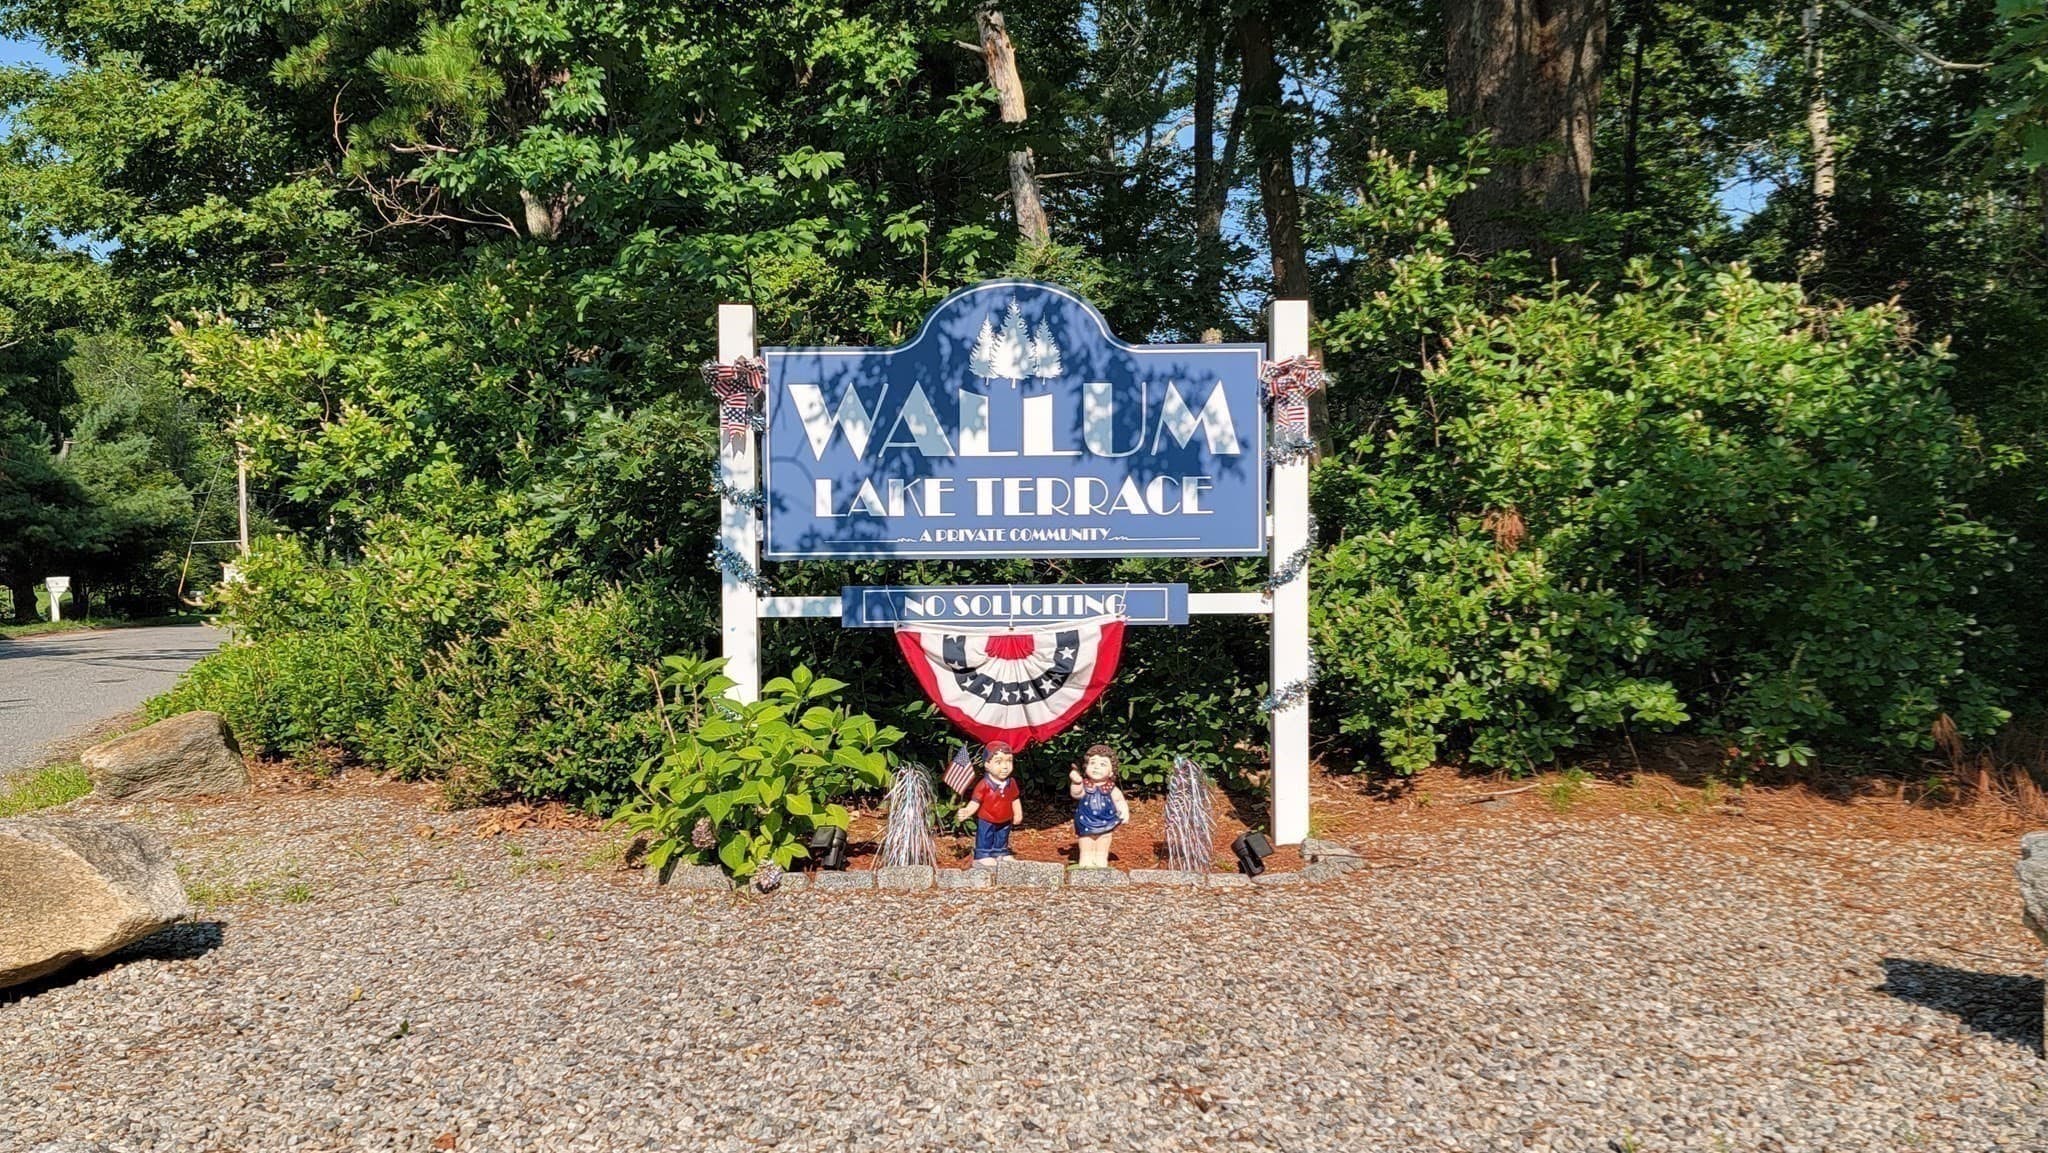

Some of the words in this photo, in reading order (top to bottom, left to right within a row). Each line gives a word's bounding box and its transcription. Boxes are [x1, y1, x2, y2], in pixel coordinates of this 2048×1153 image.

[788, 380, 1241, 462] WALLUM
[814, 477, 957, 518] LAKE
[967, 475, 1214, 516] TERRACE
[919, 528, 932, 542] A
[935, 528, 1007, 542] PRIVATE
[1010, 527, 1111, 541] COMMUNITY
[904, 594, 946, 617] NO
[953, 594, 1127, 617] SOLICITING
